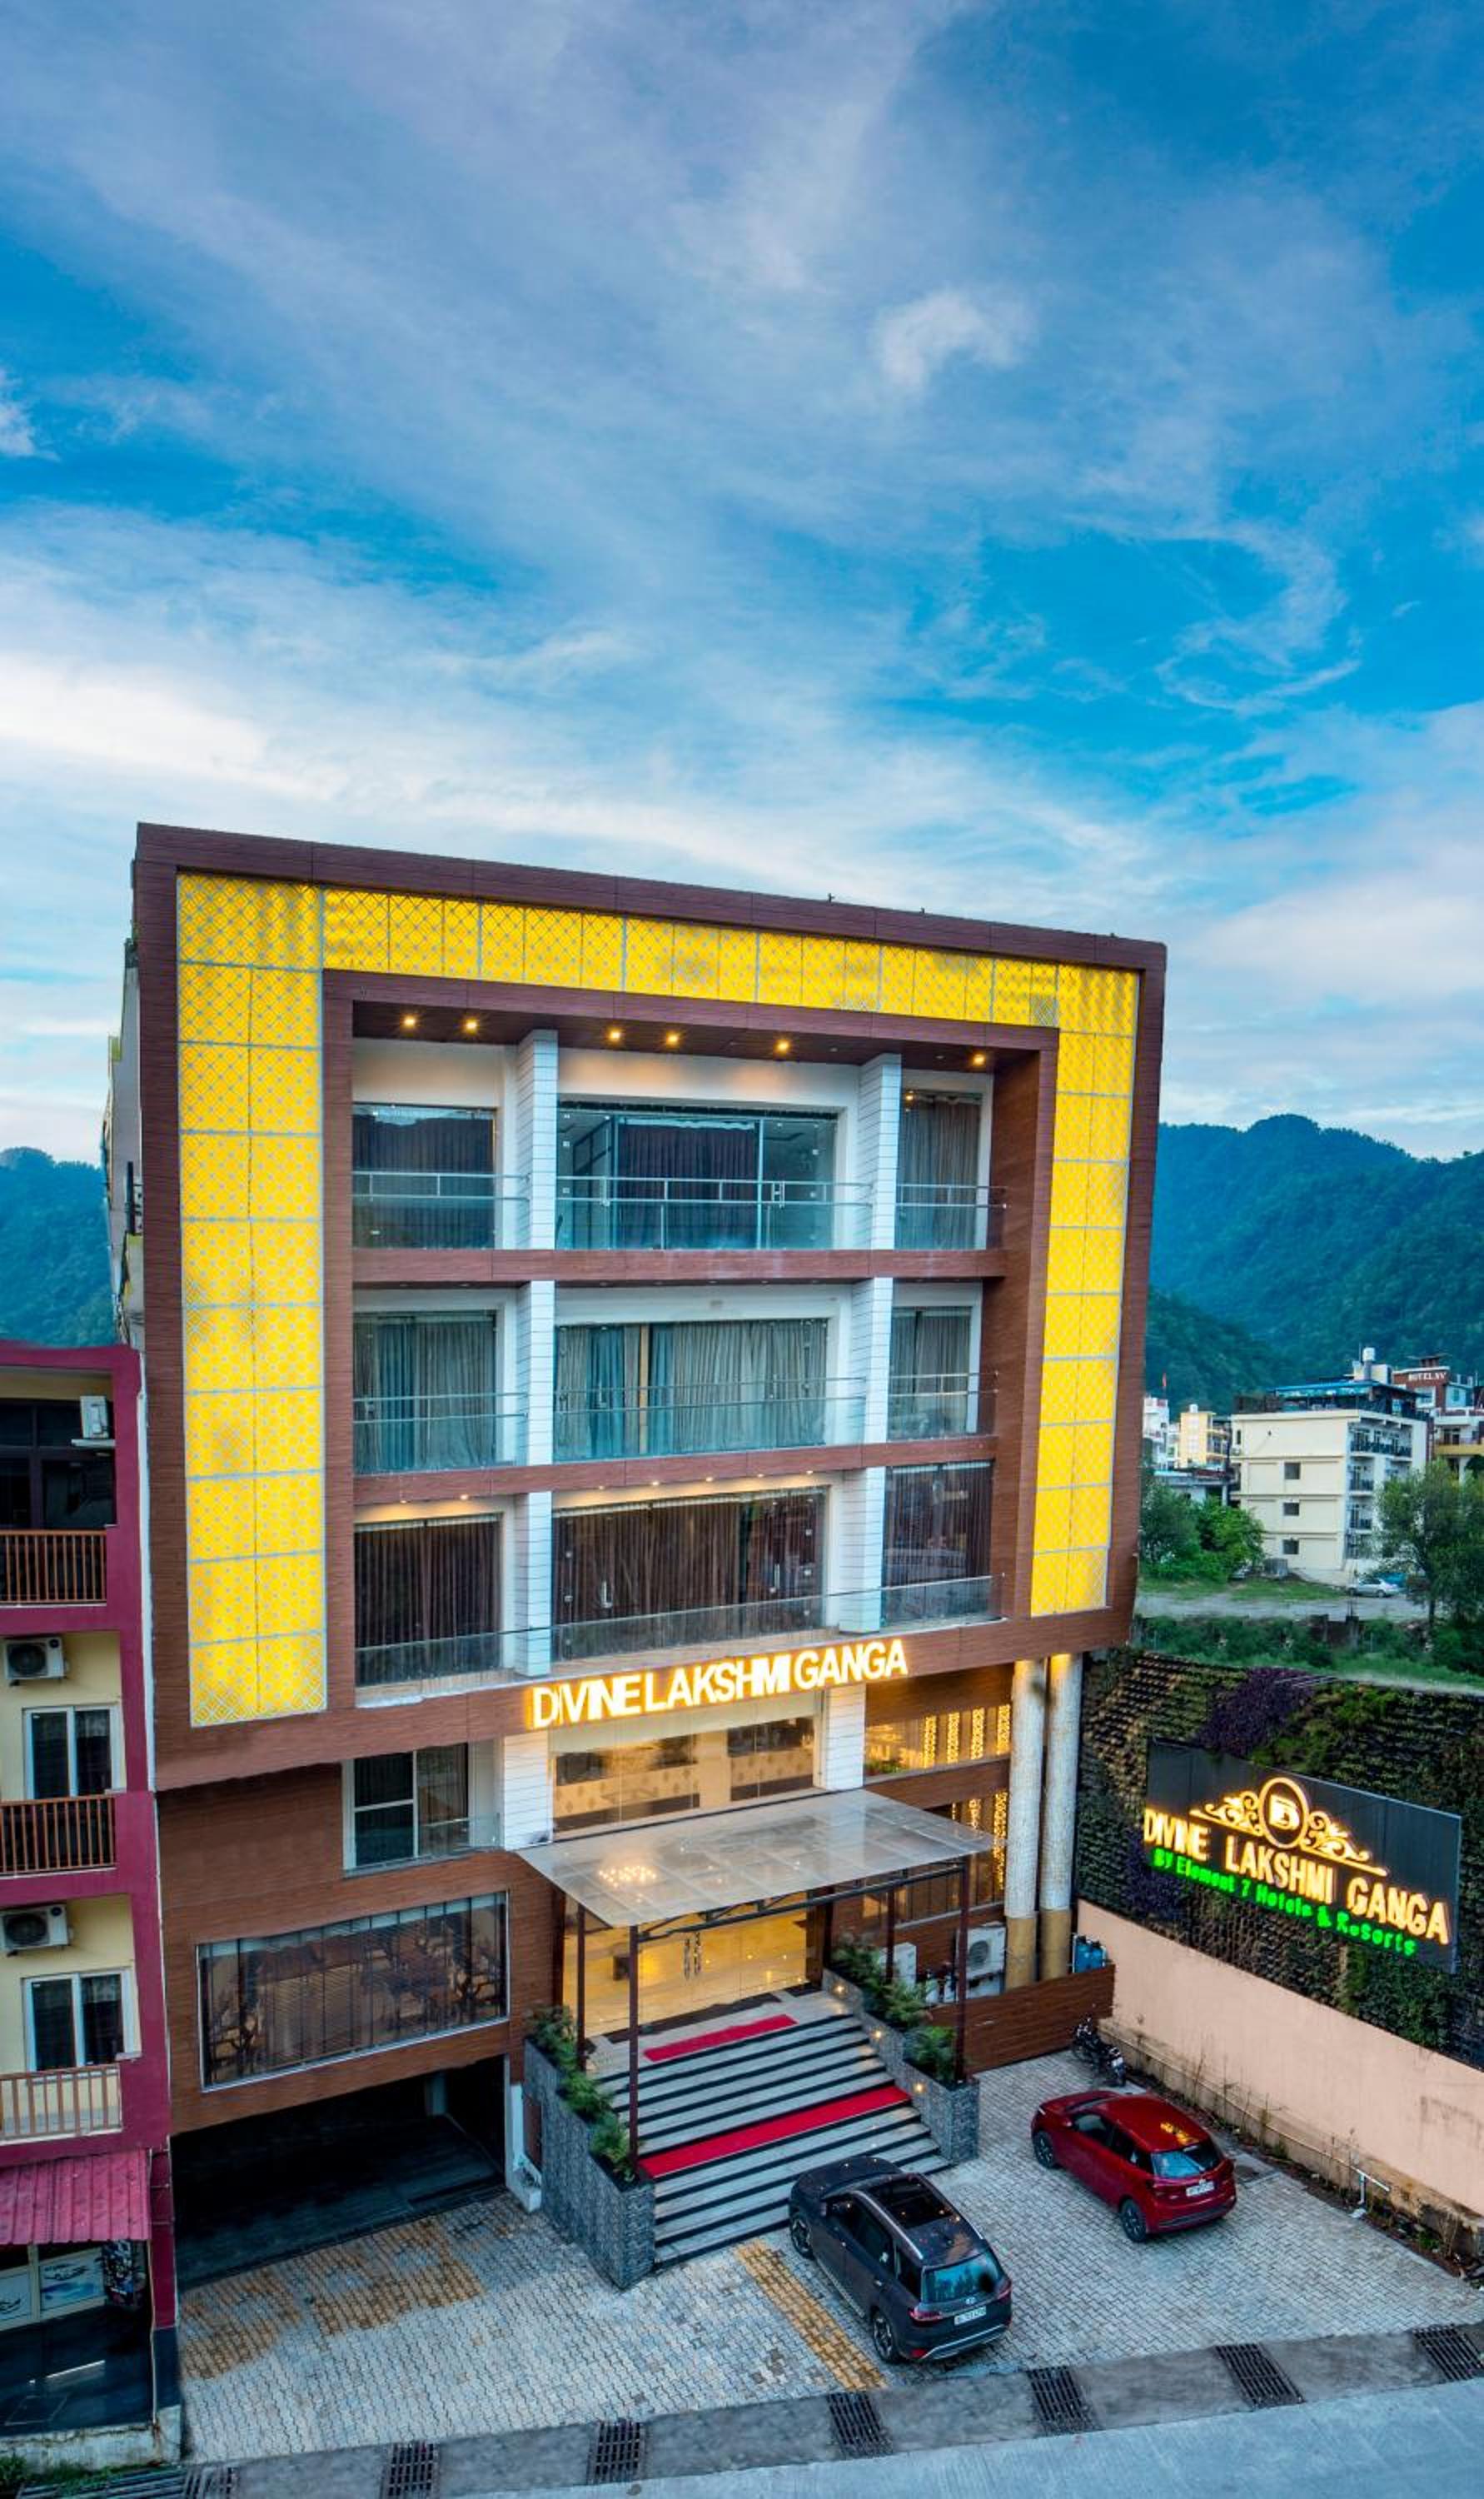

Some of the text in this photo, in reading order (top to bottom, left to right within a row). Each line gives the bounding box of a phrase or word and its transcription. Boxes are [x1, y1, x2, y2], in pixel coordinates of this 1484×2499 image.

[532, 1639, 909, 1729] DIVINE LAKSHMI GANGA
[1143, 1808, 1449, 1945] DIVINE LAKSHMI GANGA
[1153, 1848, 1416, 1956] By Element 7 Hotels & Resorts
